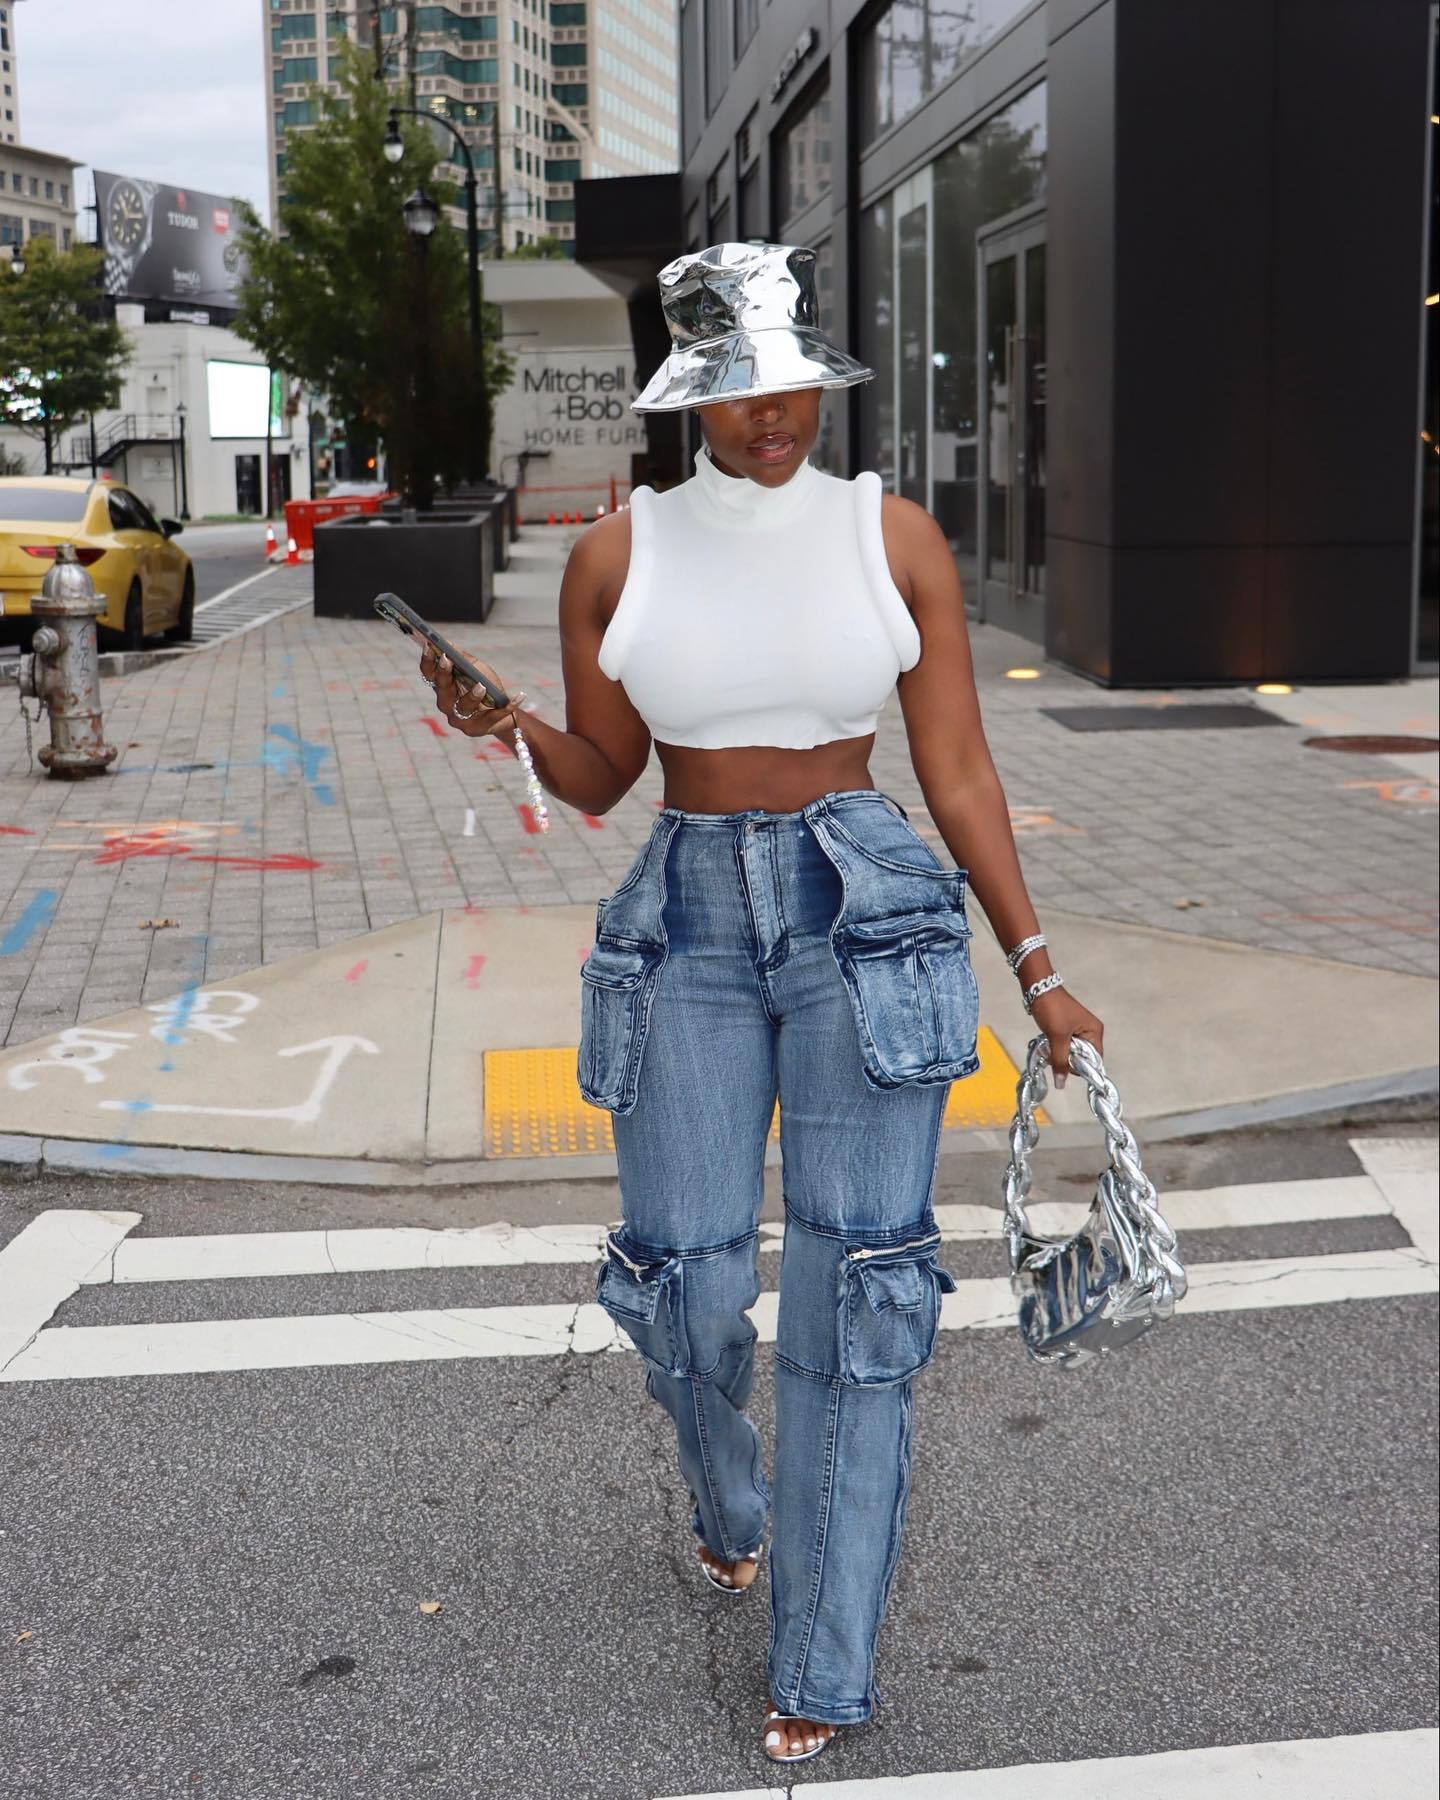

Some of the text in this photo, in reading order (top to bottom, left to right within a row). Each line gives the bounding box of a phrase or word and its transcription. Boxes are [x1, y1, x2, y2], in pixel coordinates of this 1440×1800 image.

[167, 210, 200, 230] TUDOR
[524, 365, 625, 392] Mitchell
[552, 395, 623, 421] +Bob
[525, 427, 585, 446] HOME
